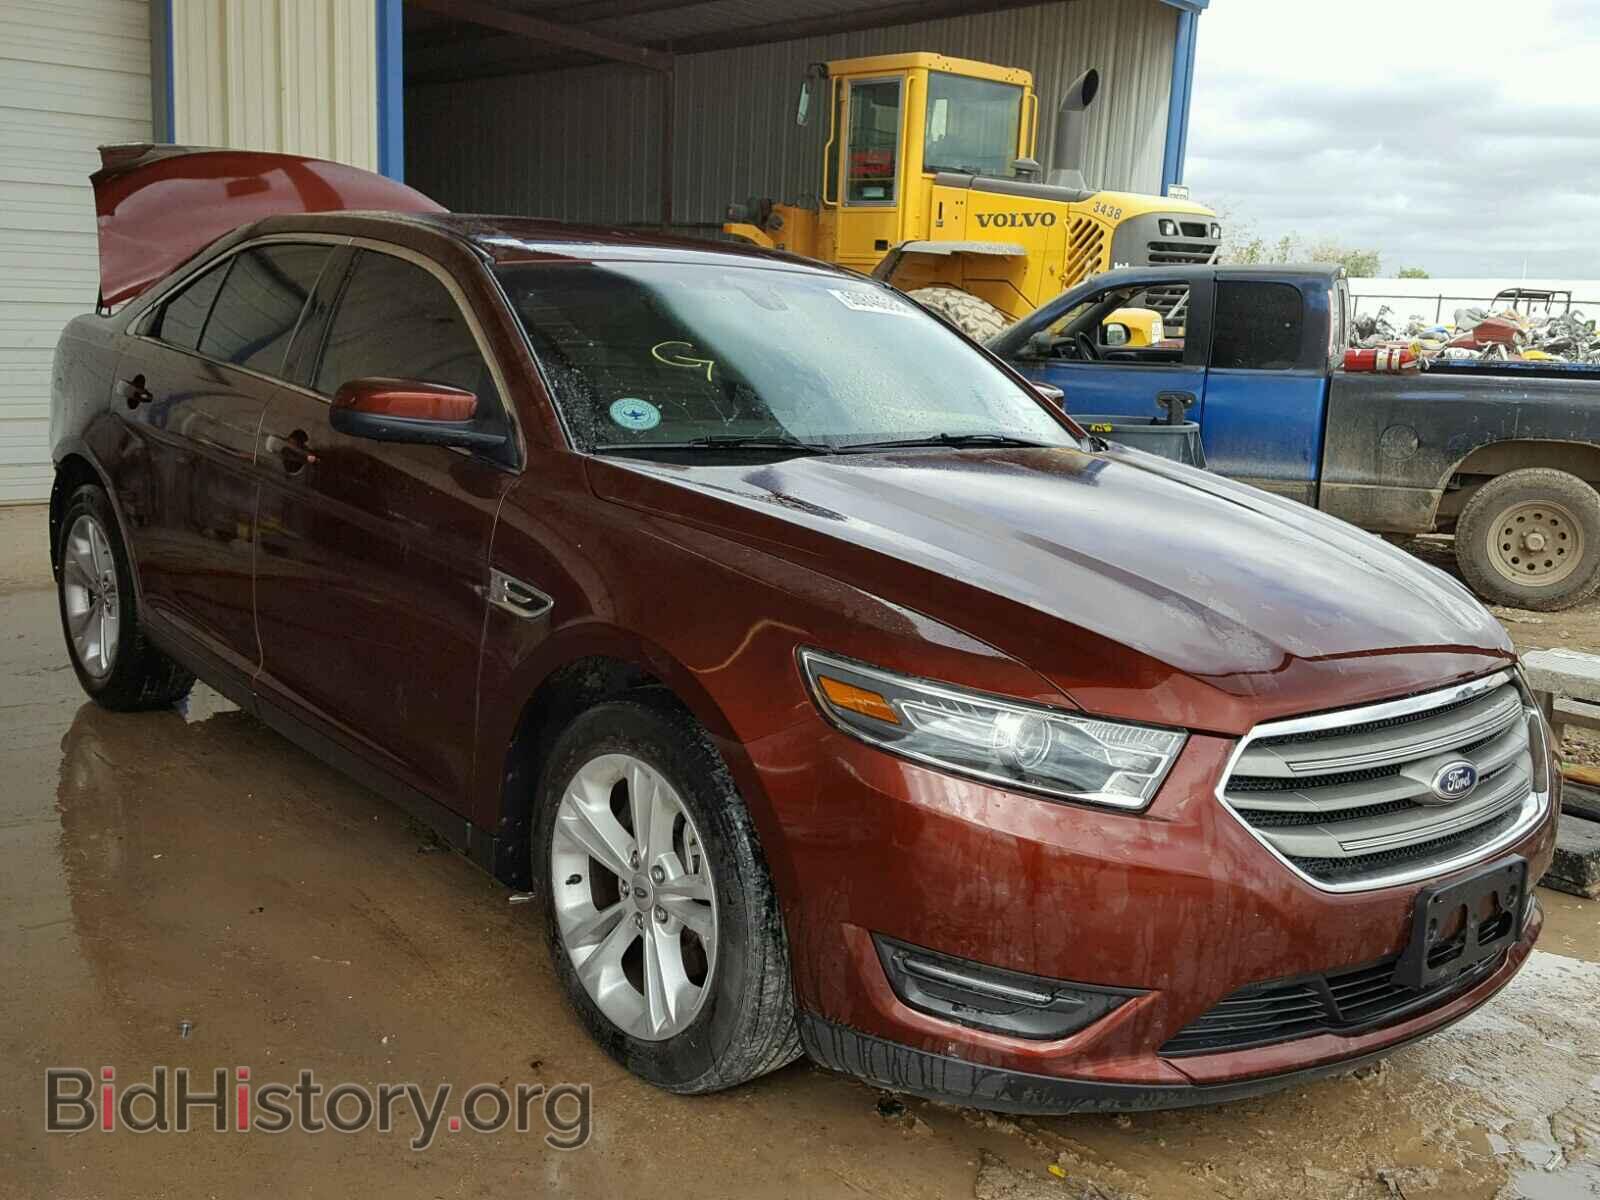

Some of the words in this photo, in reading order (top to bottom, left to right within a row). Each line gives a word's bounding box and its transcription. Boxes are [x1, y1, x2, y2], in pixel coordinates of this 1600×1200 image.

[974, 212, 1057, 228] VOLVO
[1093, 201, 1121, 220] 3438
[1447, 768, 1472, 792] Ford
